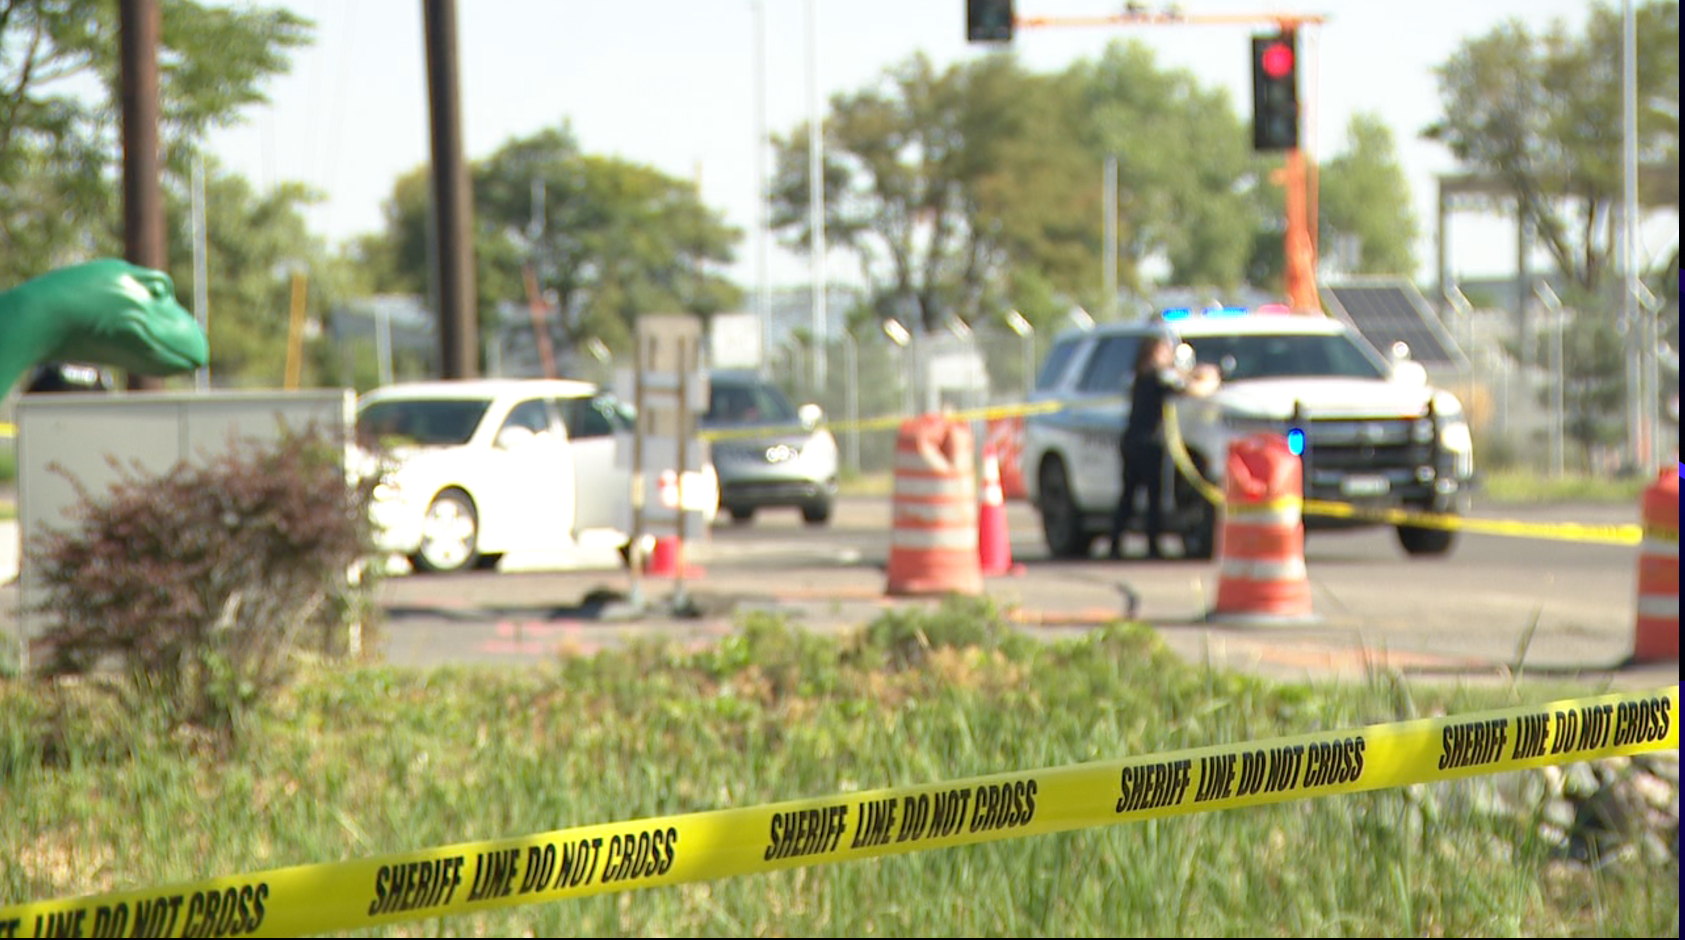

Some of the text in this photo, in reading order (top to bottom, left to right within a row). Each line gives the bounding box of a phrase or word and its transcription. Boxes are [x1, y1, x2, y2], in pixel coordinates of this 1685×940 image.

[1438, 696, 1671, 770] SHERIFF LINE DO NOT CROSS
[1116, 736, 1365, 813] SHERIFF LINE DO NOT CROSS
[764, 779, 1037, 861] SHERIFF LINE DO NOT CROSS
[368, 827, 677, 916] SHERIFF LINE DO NOT CROSS
[129, 896, 183, 938] NOT
[185, 884, 269, 938] CROSS
